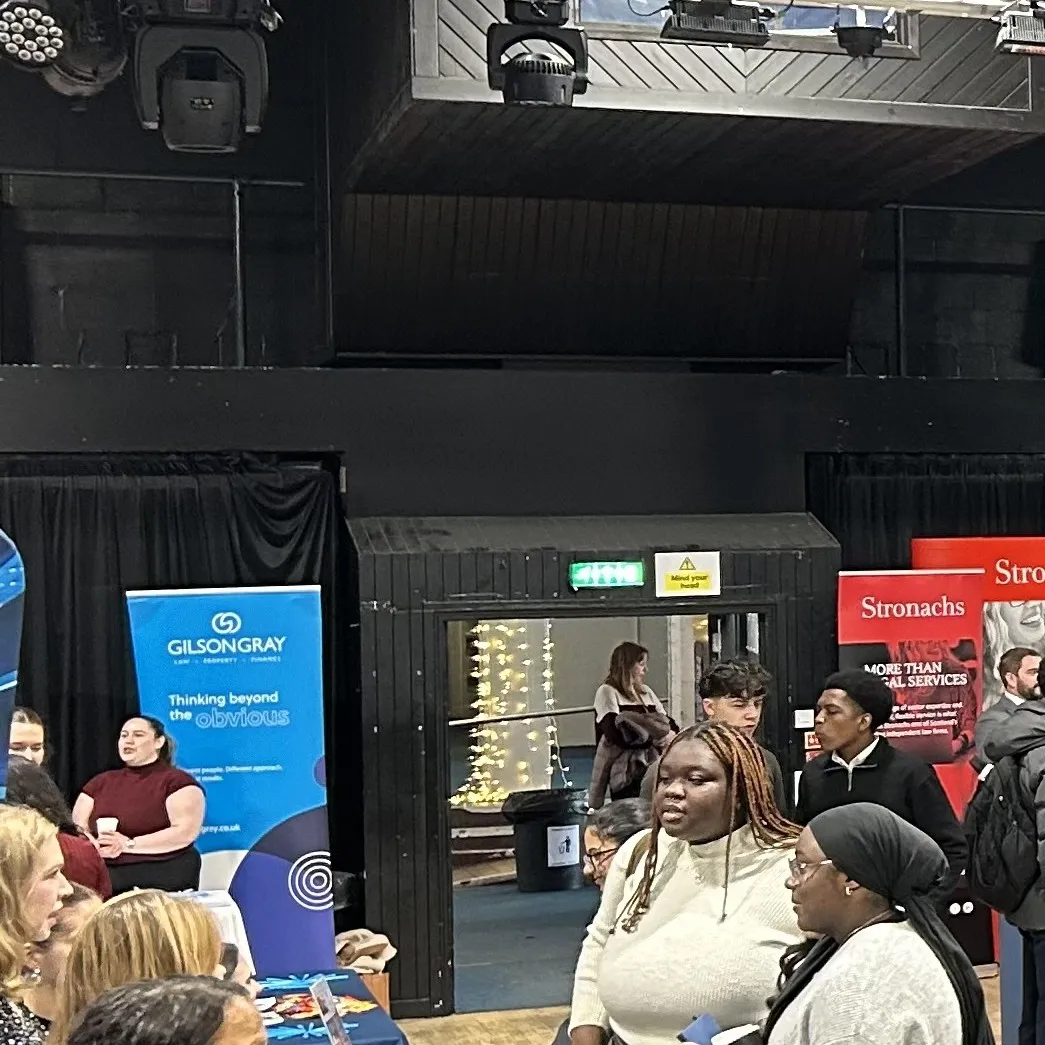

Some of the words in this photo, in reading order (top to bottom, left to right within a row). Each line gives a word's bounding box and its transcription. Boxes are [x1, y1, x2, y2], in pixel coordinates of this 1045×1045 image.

[861, 595, 965, 619] Stronachs
[864, 663, 902, 676] MORE
[904, 662, 942, 674] THAN
[881, 676, 906, 688] GAL
[908, 673, 968, 688] SERVICES
[169, 693, 226, 707] Thinking
[229, 691, 279, 706] beyond
[169, 709, 192, 721] the
[196, 707, 290, 729] obvious
[201, 824, 240, 833] gray.co.uk
